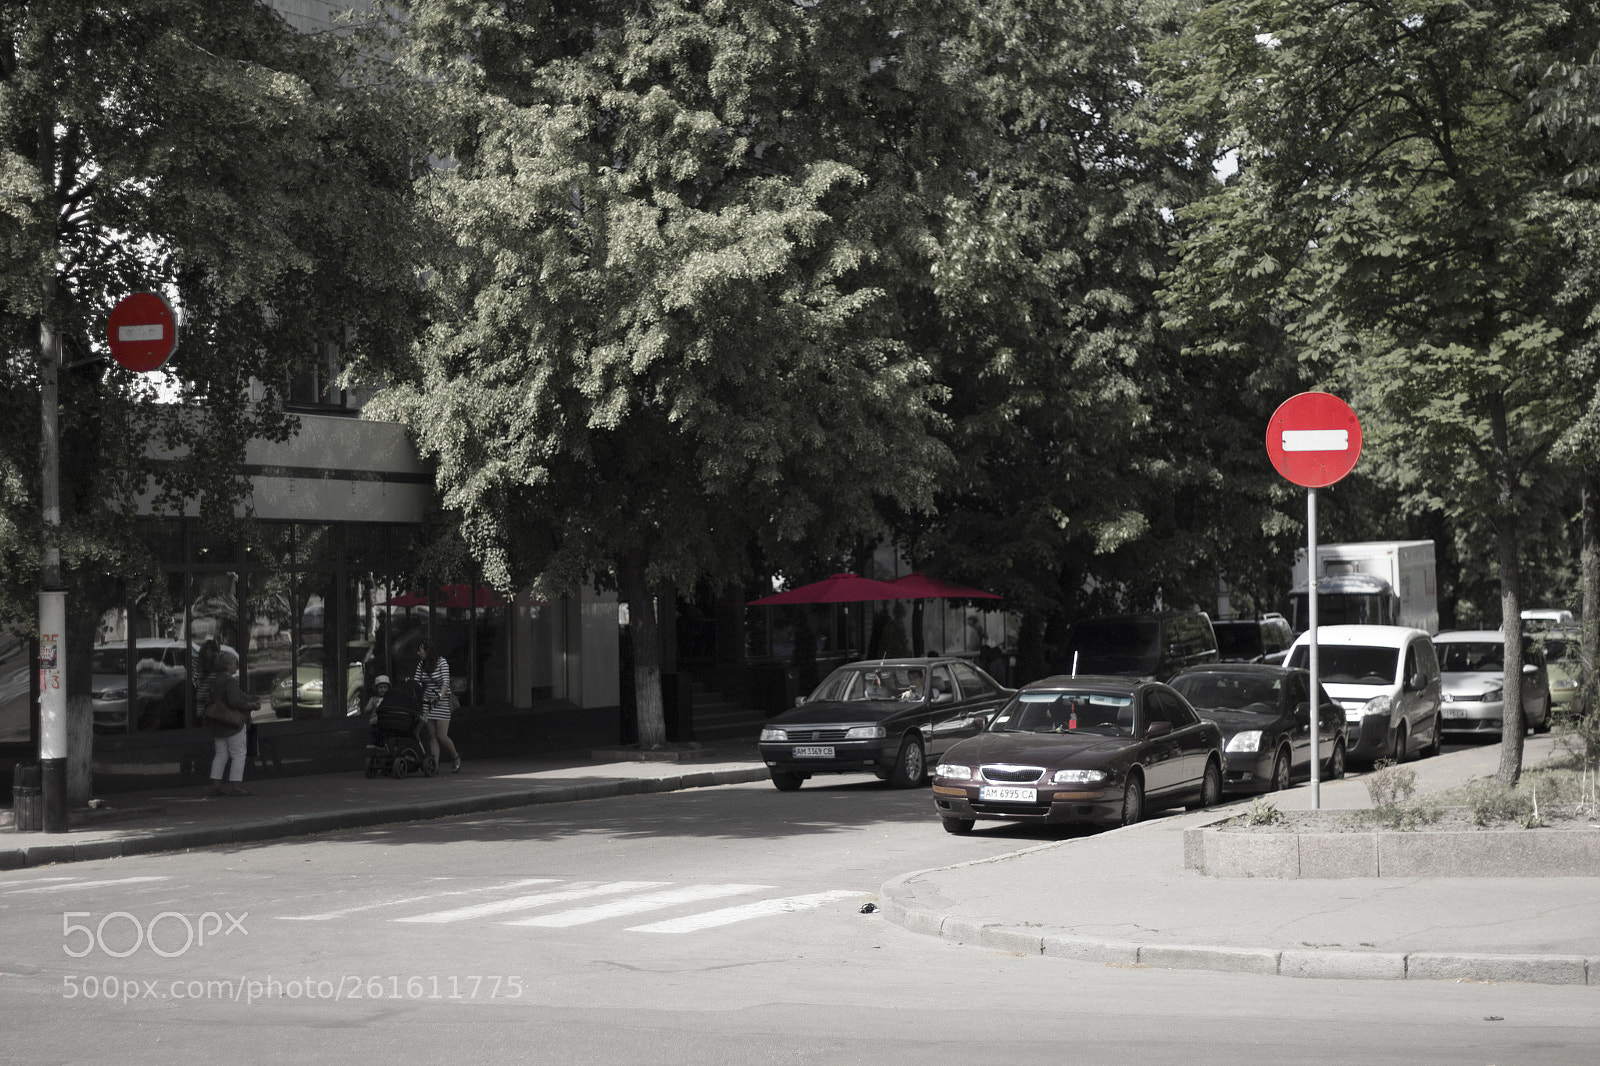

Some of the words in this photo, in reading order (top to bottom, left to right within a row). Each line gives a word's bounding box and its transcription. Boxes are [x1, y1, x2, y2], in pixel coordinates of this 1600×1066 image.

[986, 789, 997, 797] AM
[1000, 789, 1019, 798] 6995
[1022, 790, 1034, 799] CA
